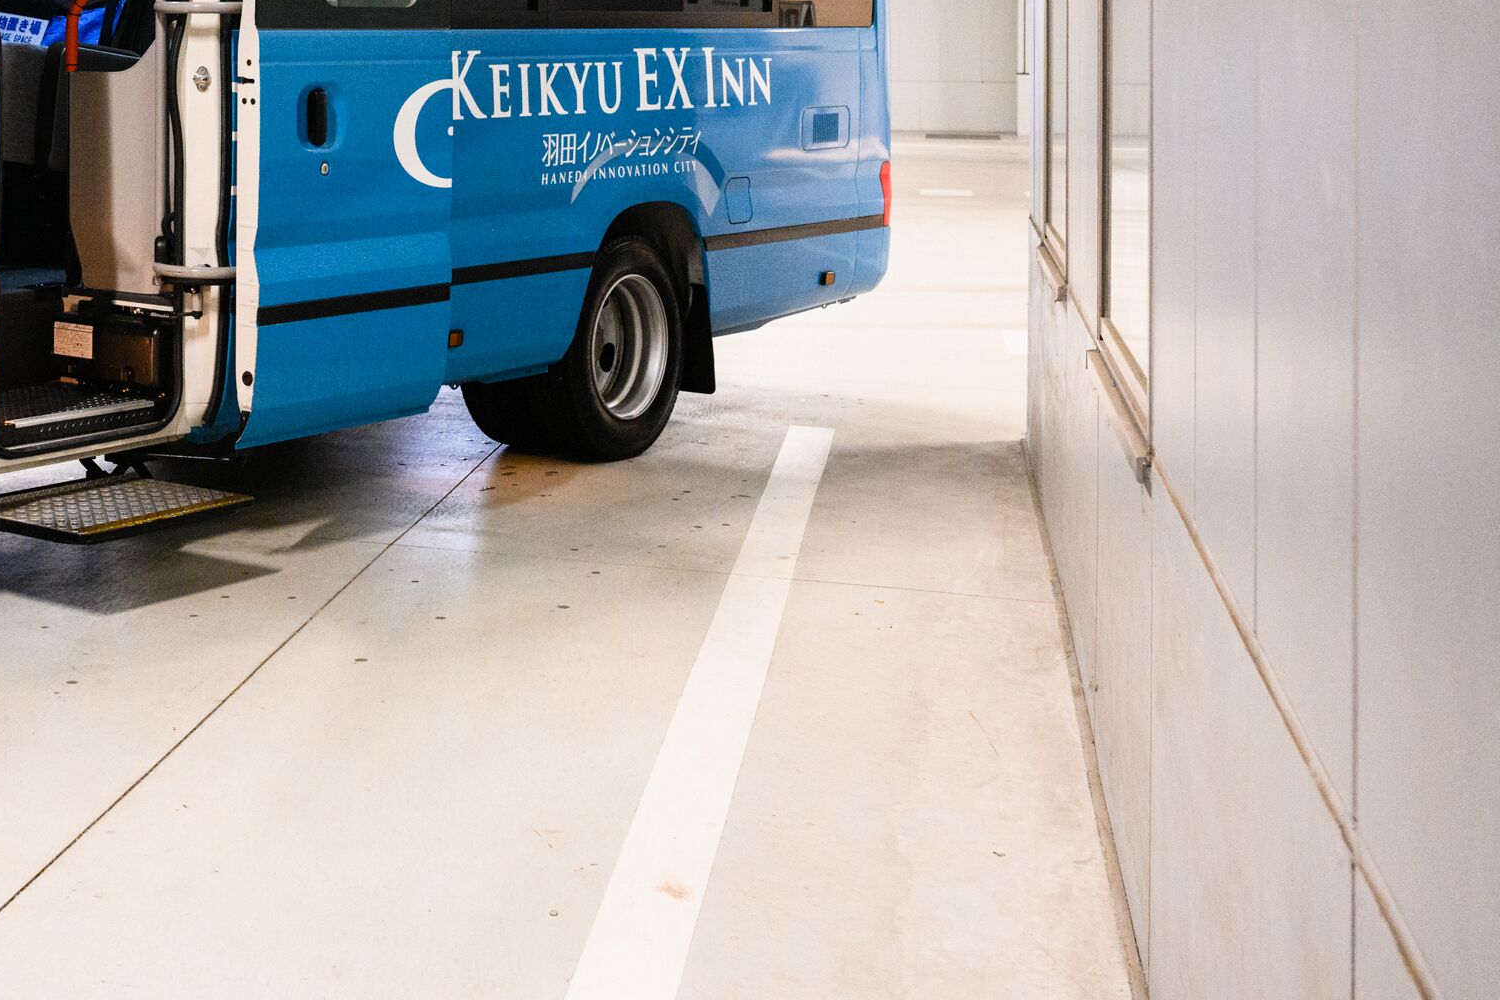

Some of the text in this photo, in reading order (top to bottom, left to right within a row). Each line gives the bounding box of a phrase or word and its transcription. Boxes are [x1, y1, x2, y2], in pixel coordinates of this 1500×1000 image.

[13, 34, 33, 44] SPACE
[451, 47, 772, 120] KEIKYU EX INN
[542, 127, 702, 167] 羽田イノベーションシティ
[541, 160, 697, 186] HANEDA INNOVATION CITY
